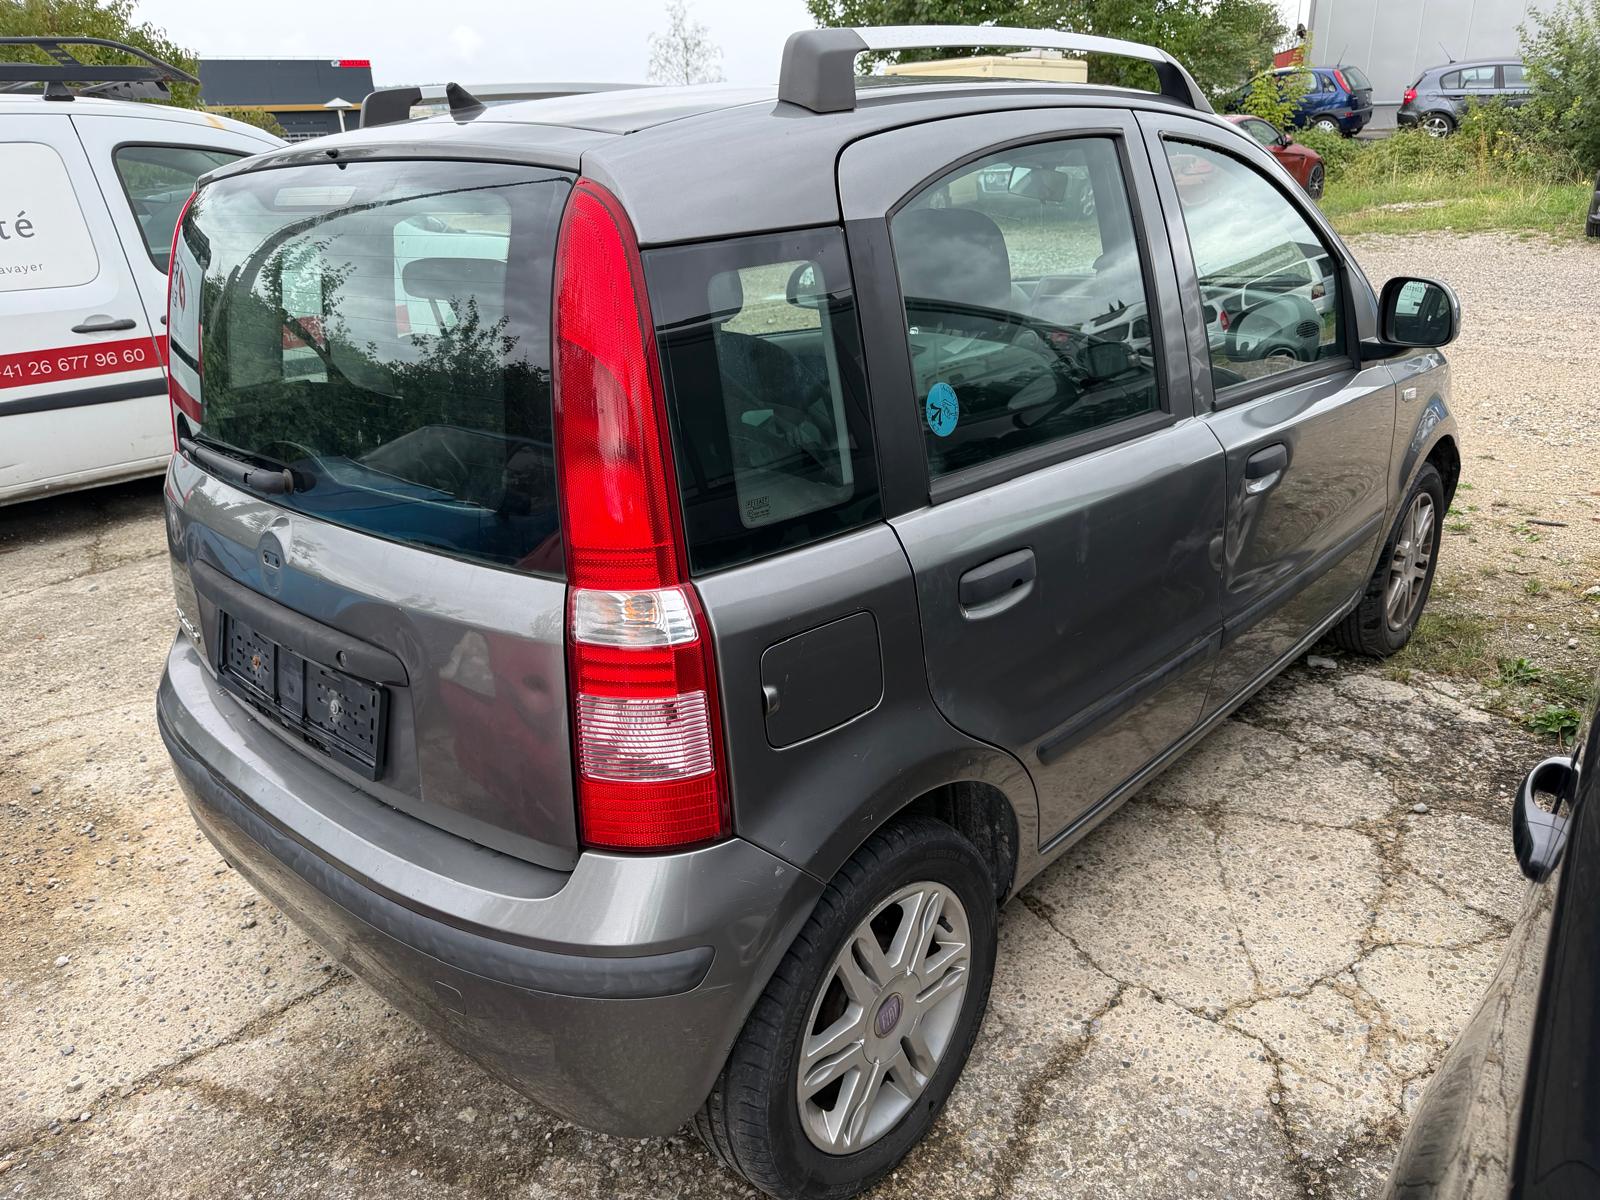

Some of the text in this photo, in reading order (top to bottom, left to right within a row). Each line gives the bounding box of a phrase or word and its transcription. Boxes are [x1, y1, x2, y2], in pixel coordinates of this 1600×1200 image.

[0, 348, 145, 378] 41 26 677 96 60
[881, 1001, 898, 1031] FIAT
